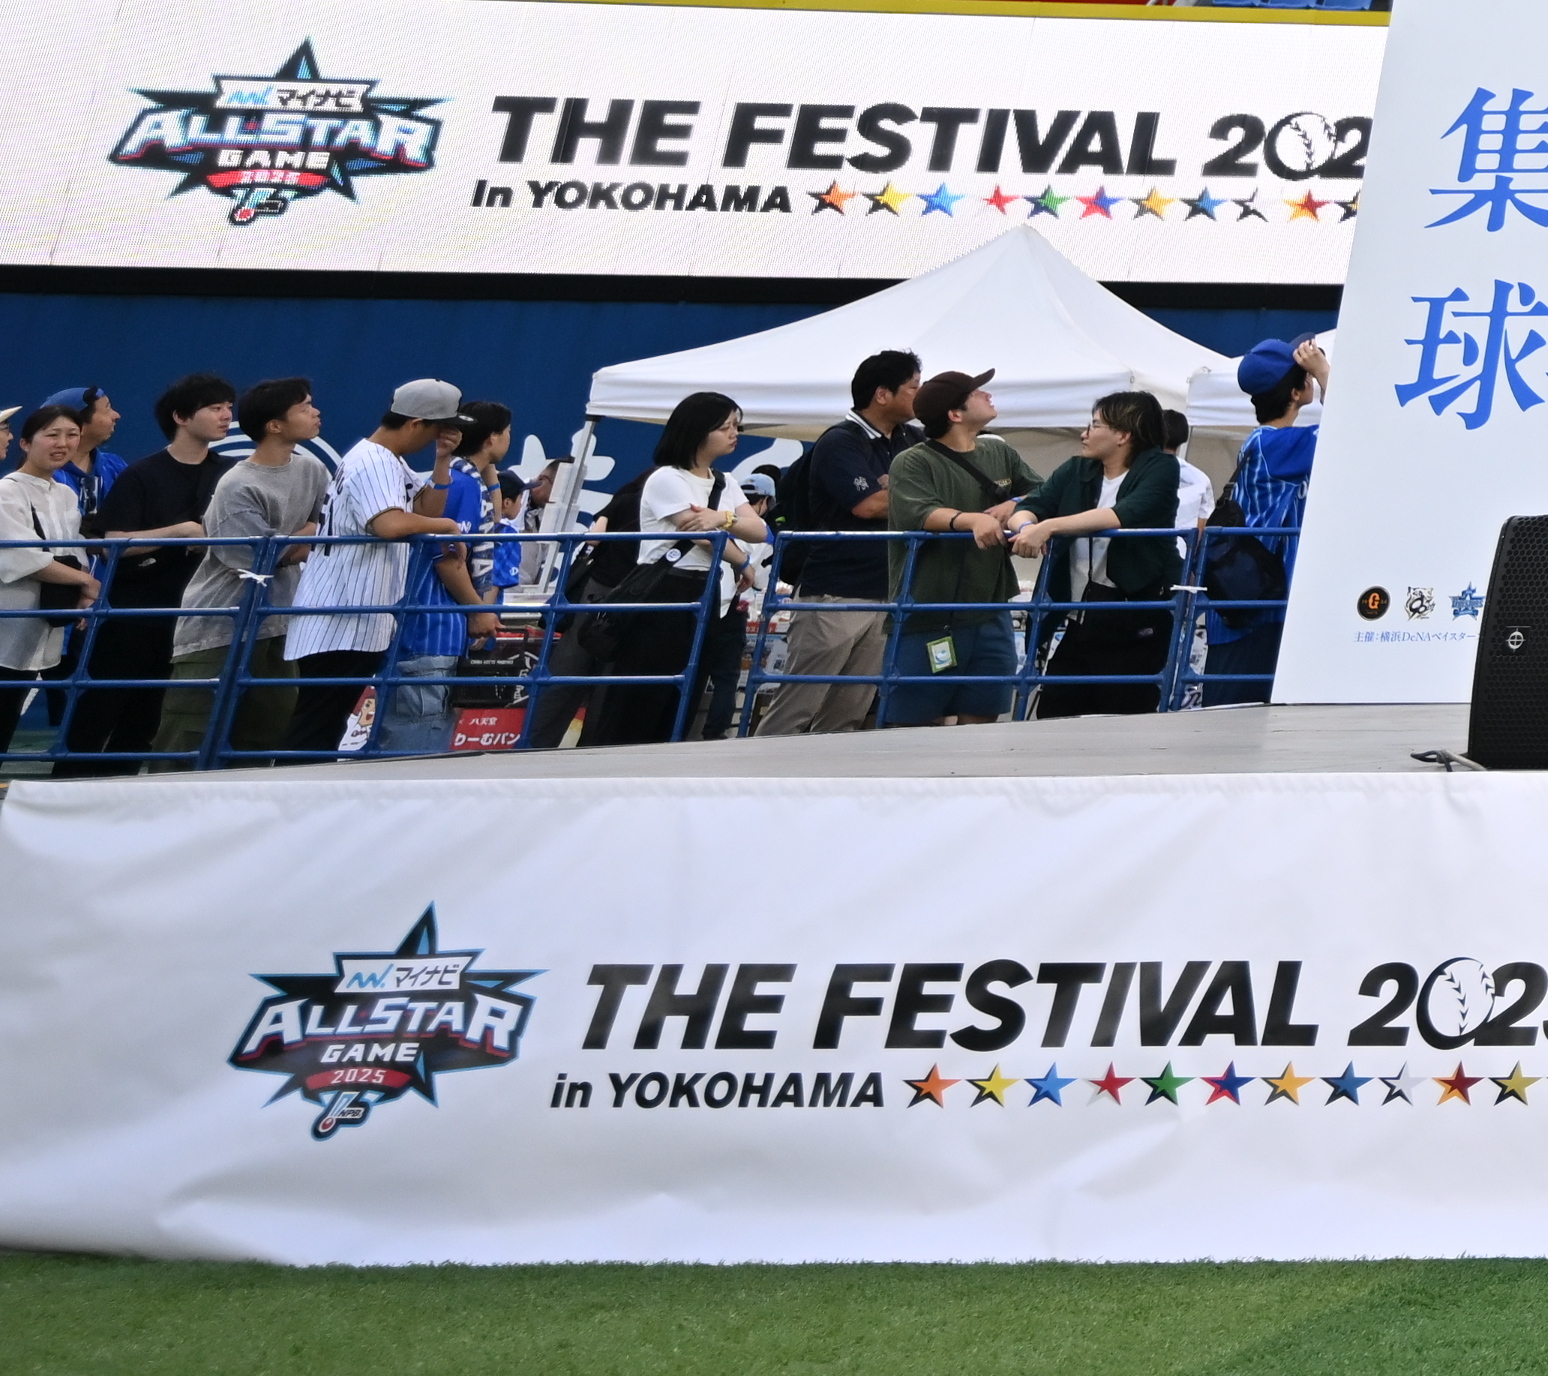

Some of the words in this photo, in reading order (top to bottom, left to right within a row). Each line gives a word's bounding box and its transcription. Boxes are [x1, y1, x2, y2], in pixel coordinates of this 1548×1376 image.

[276, 87, 360, 111] マイナビ
[492, 95, 701, 168] THE
[722, 101, 1177, 176] FESTIVAL
[216, 149, 332, 172] GAME
[530, 179, 792, 214] YOKOHAMA
[1354, 630, 1479, 643] 主催：横浜DeNAベイスター
[394, 964, 460, 989] マイナビ
[581, 962, 795, 1050] THE
[813, 959, 1319, 1052] FESTIVAL
[320, 1042, 421, 1063] GAME
[331, 1067, 386, 1086] 2025
[549, 1071, 593, 1109] in
[607, 1071, 885, 1109] YOKOHAMA
